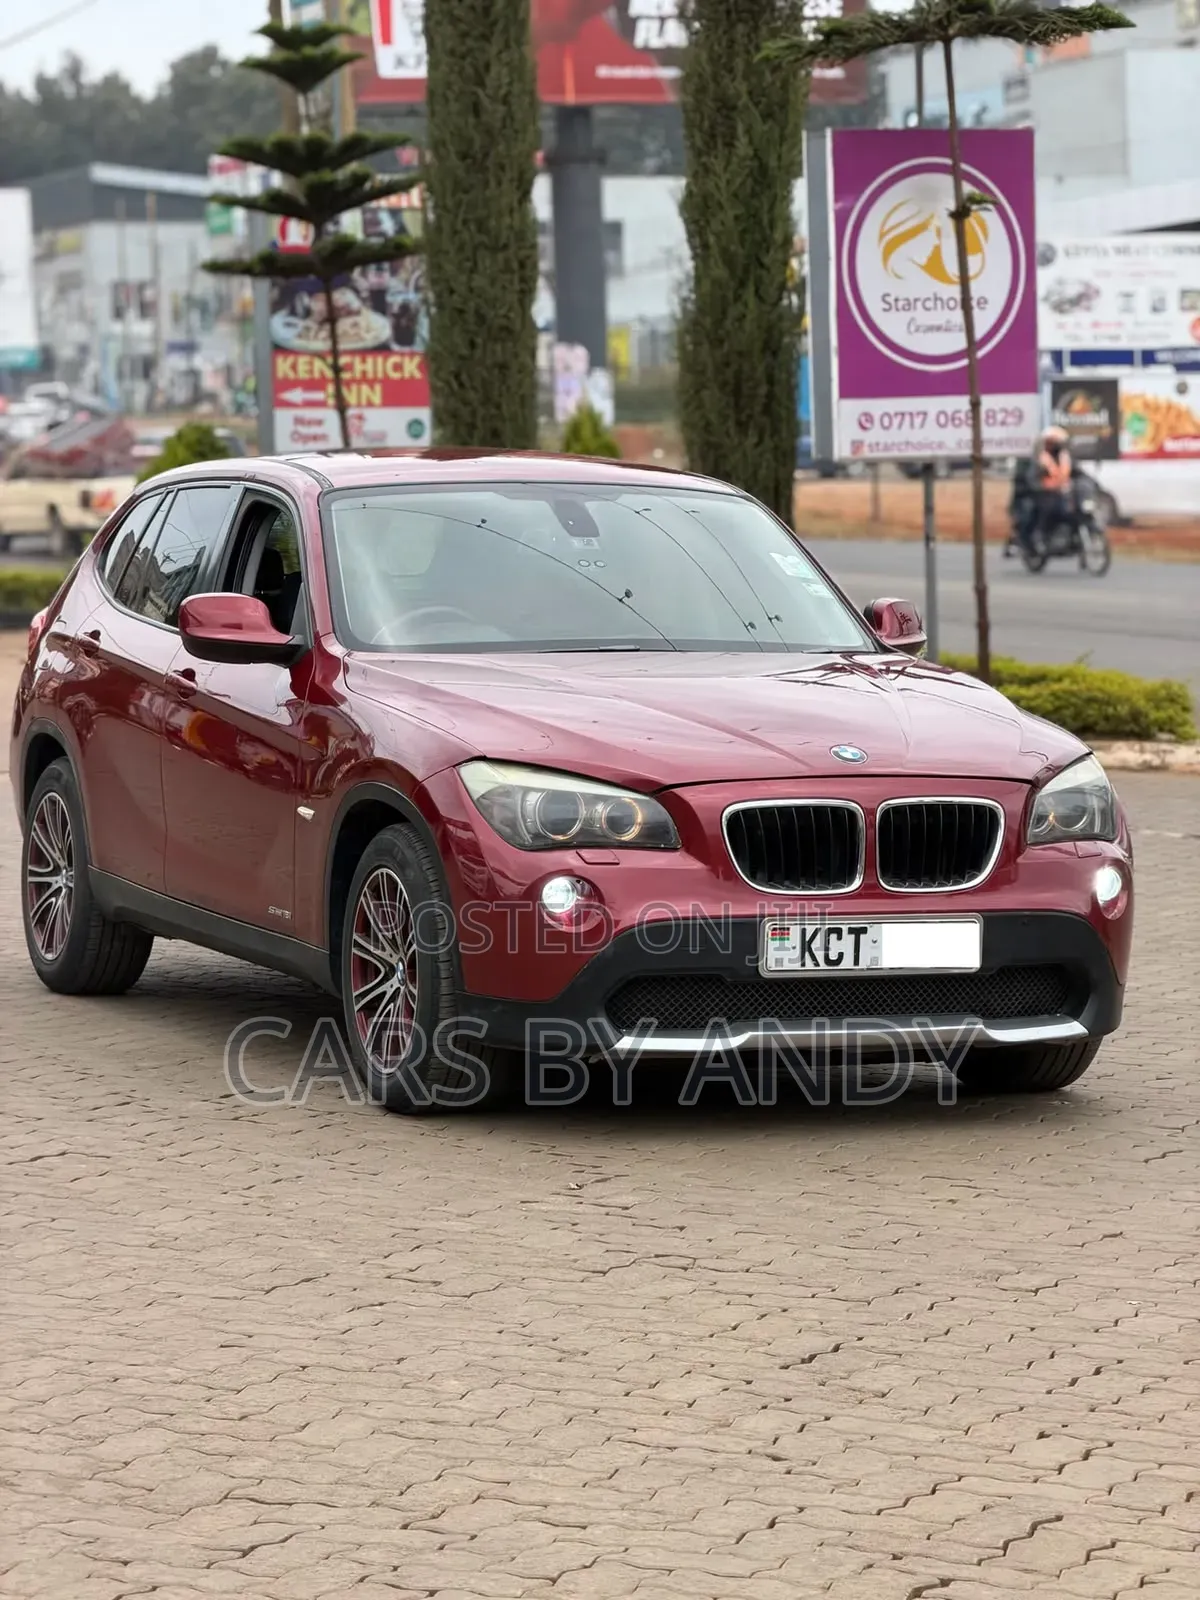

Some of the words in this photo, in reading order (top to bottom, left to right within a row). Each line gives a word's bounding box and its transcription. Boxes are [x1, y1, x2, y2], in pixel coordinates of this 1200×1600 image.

[881, 293, 989, 312] Starchoe
[275, 355, 422, 380] KENCHICK
[325, 383, 383, 406] INN
[879, 411, 928, 431] 0717
[984, 407, 1024, 427] 829
[801, 926, 868, 968] KCT
